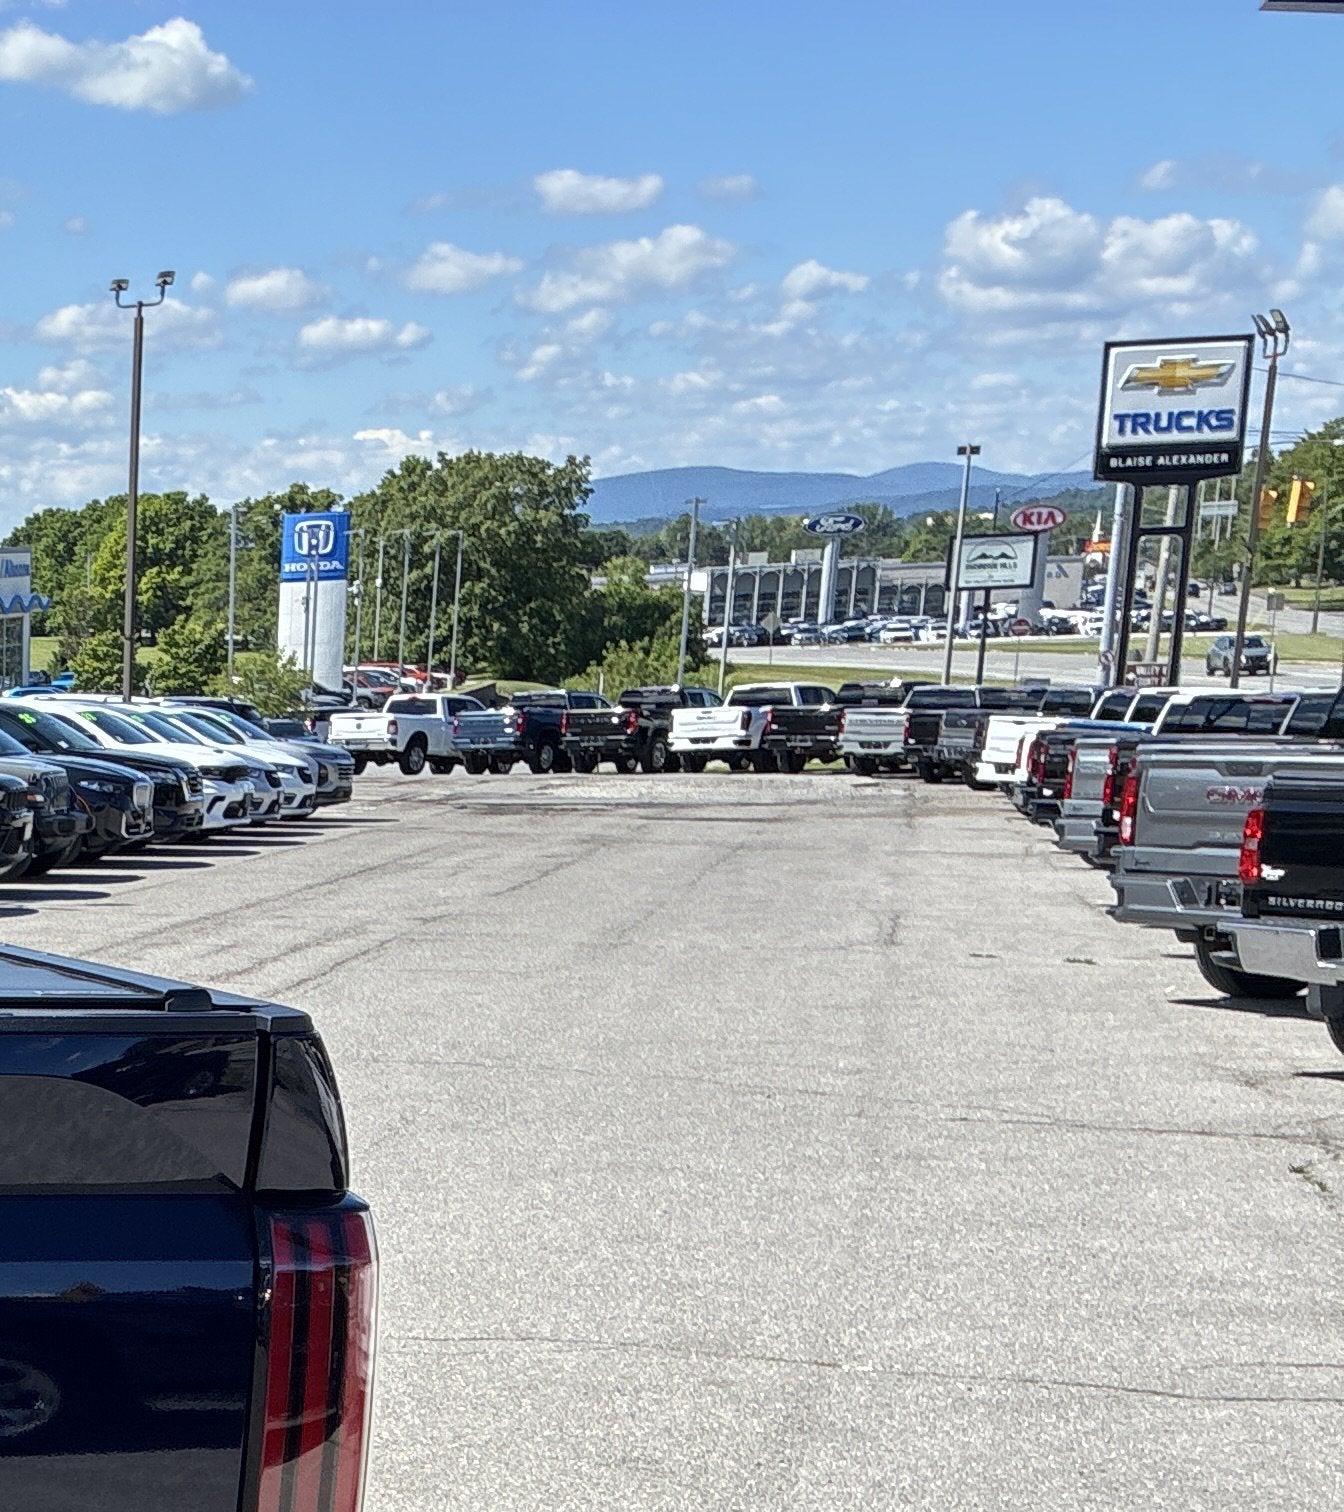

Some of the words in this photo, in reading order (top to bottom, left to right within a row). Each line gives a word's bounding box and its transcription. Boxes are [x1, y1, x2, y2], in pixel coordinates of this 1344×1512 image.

[1113, 408, 1236, 436] TRUCKS
[1109, 455, 1153, 468] BLAISE
[1157, 452, 1229, 467] ALEXANDER
[815, 516, 854, 533] Ford
[1022, 509, 1057, 526] KIA
